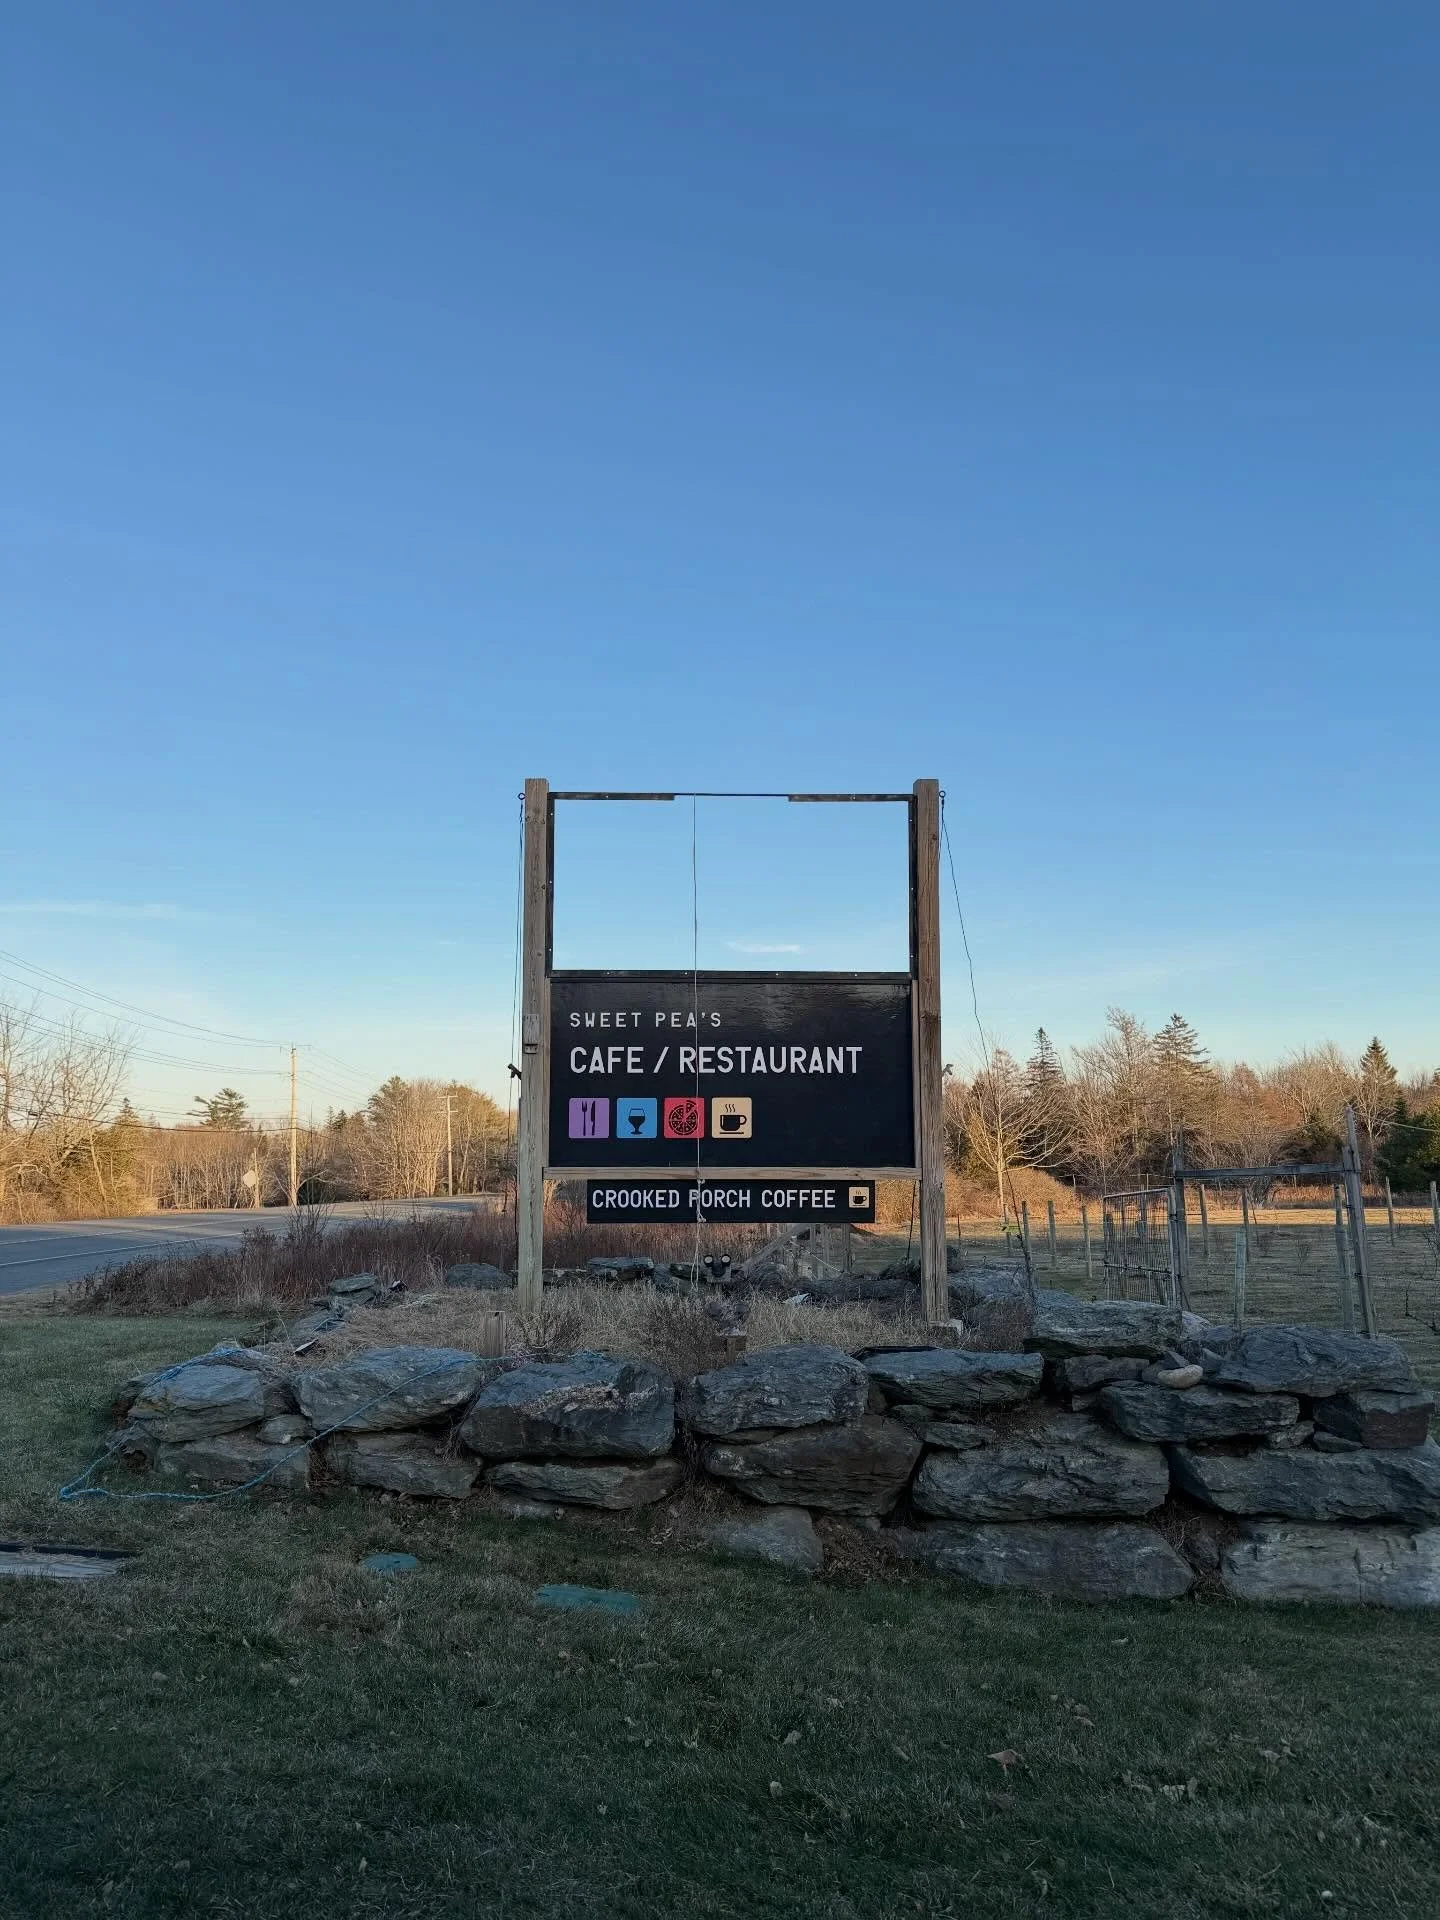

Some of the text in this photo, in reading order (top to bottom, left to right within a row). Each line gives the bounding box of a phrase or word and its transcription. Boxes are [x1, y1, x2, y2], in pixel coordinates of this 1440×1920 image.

[570, 1012, 722, 1028] SWEET PEA'S
[570, 1046, 863, 1074] CAFE / RESTAURANT
[592, 1189, 836, 1209] CROOKED PORCH COFFEE
